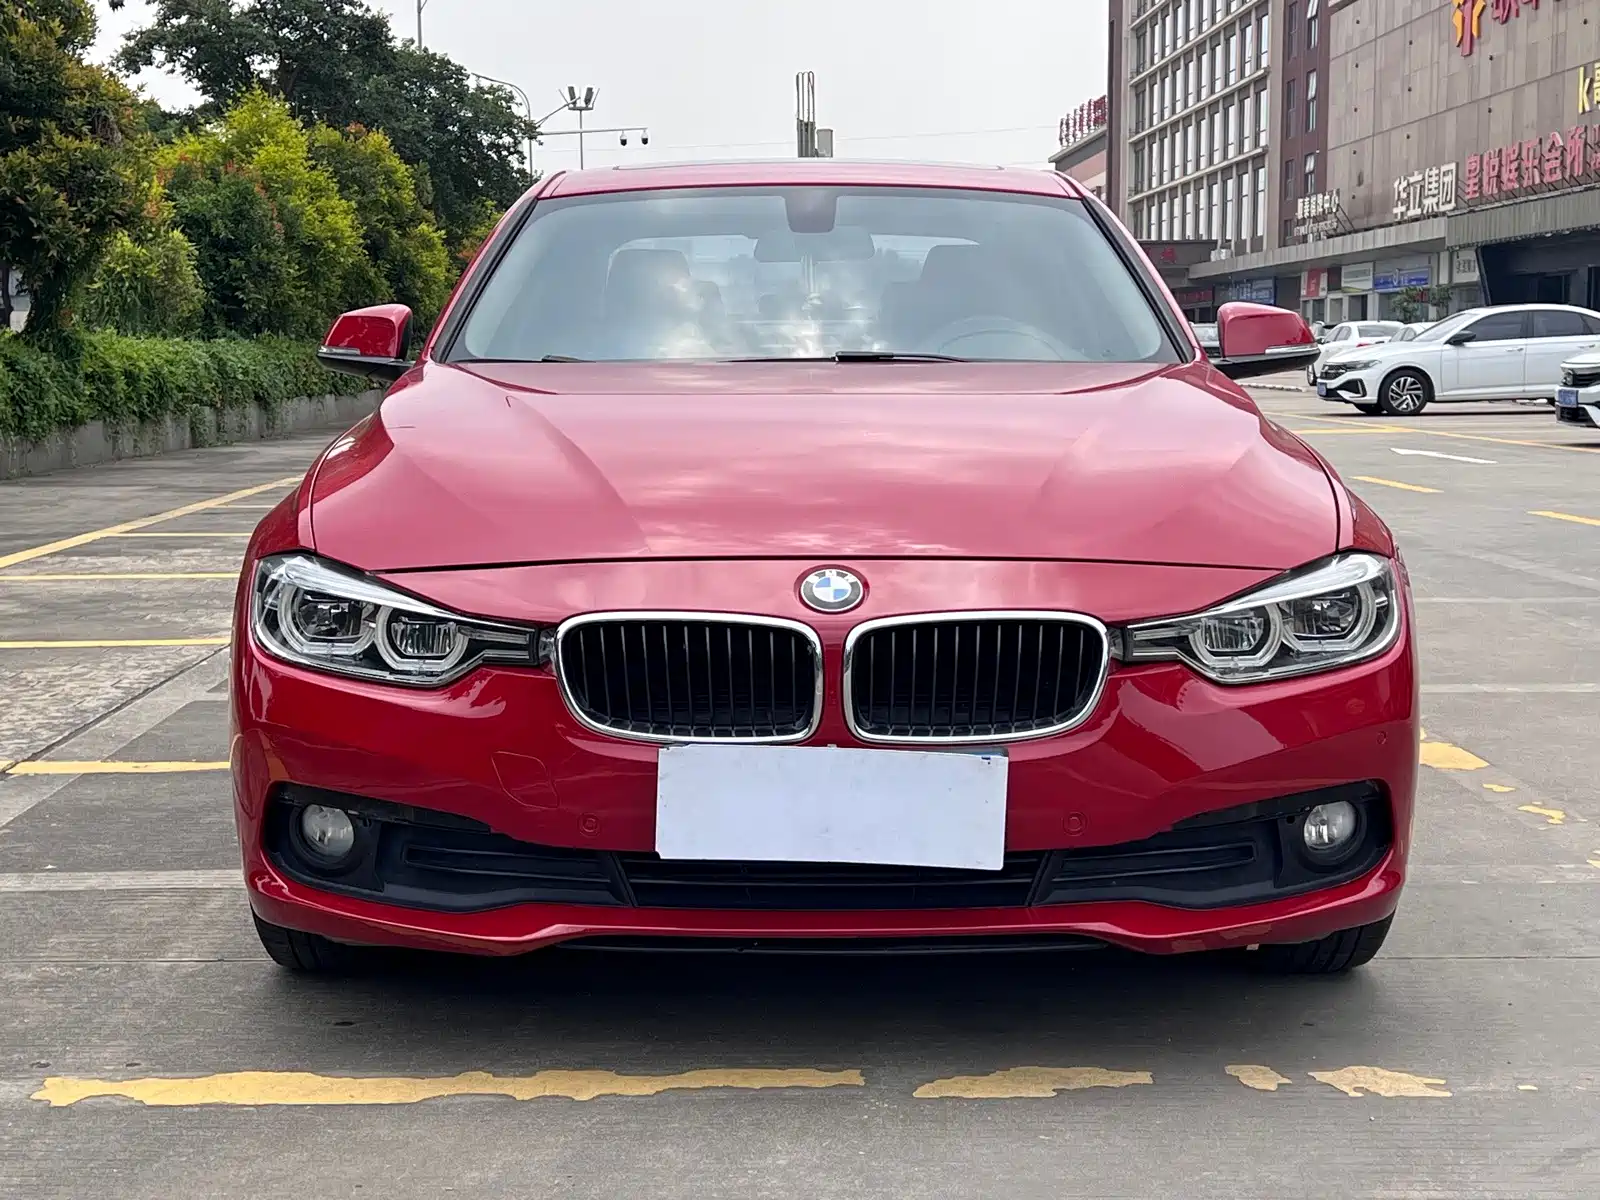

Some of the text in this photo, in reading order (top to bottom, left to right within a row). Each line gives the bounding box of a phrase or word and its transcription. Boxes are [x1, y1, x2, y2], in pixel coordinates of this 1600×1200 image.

[1393, 162, 1456, 221] 华立集团
[805, 569, 858, 584] BMW
